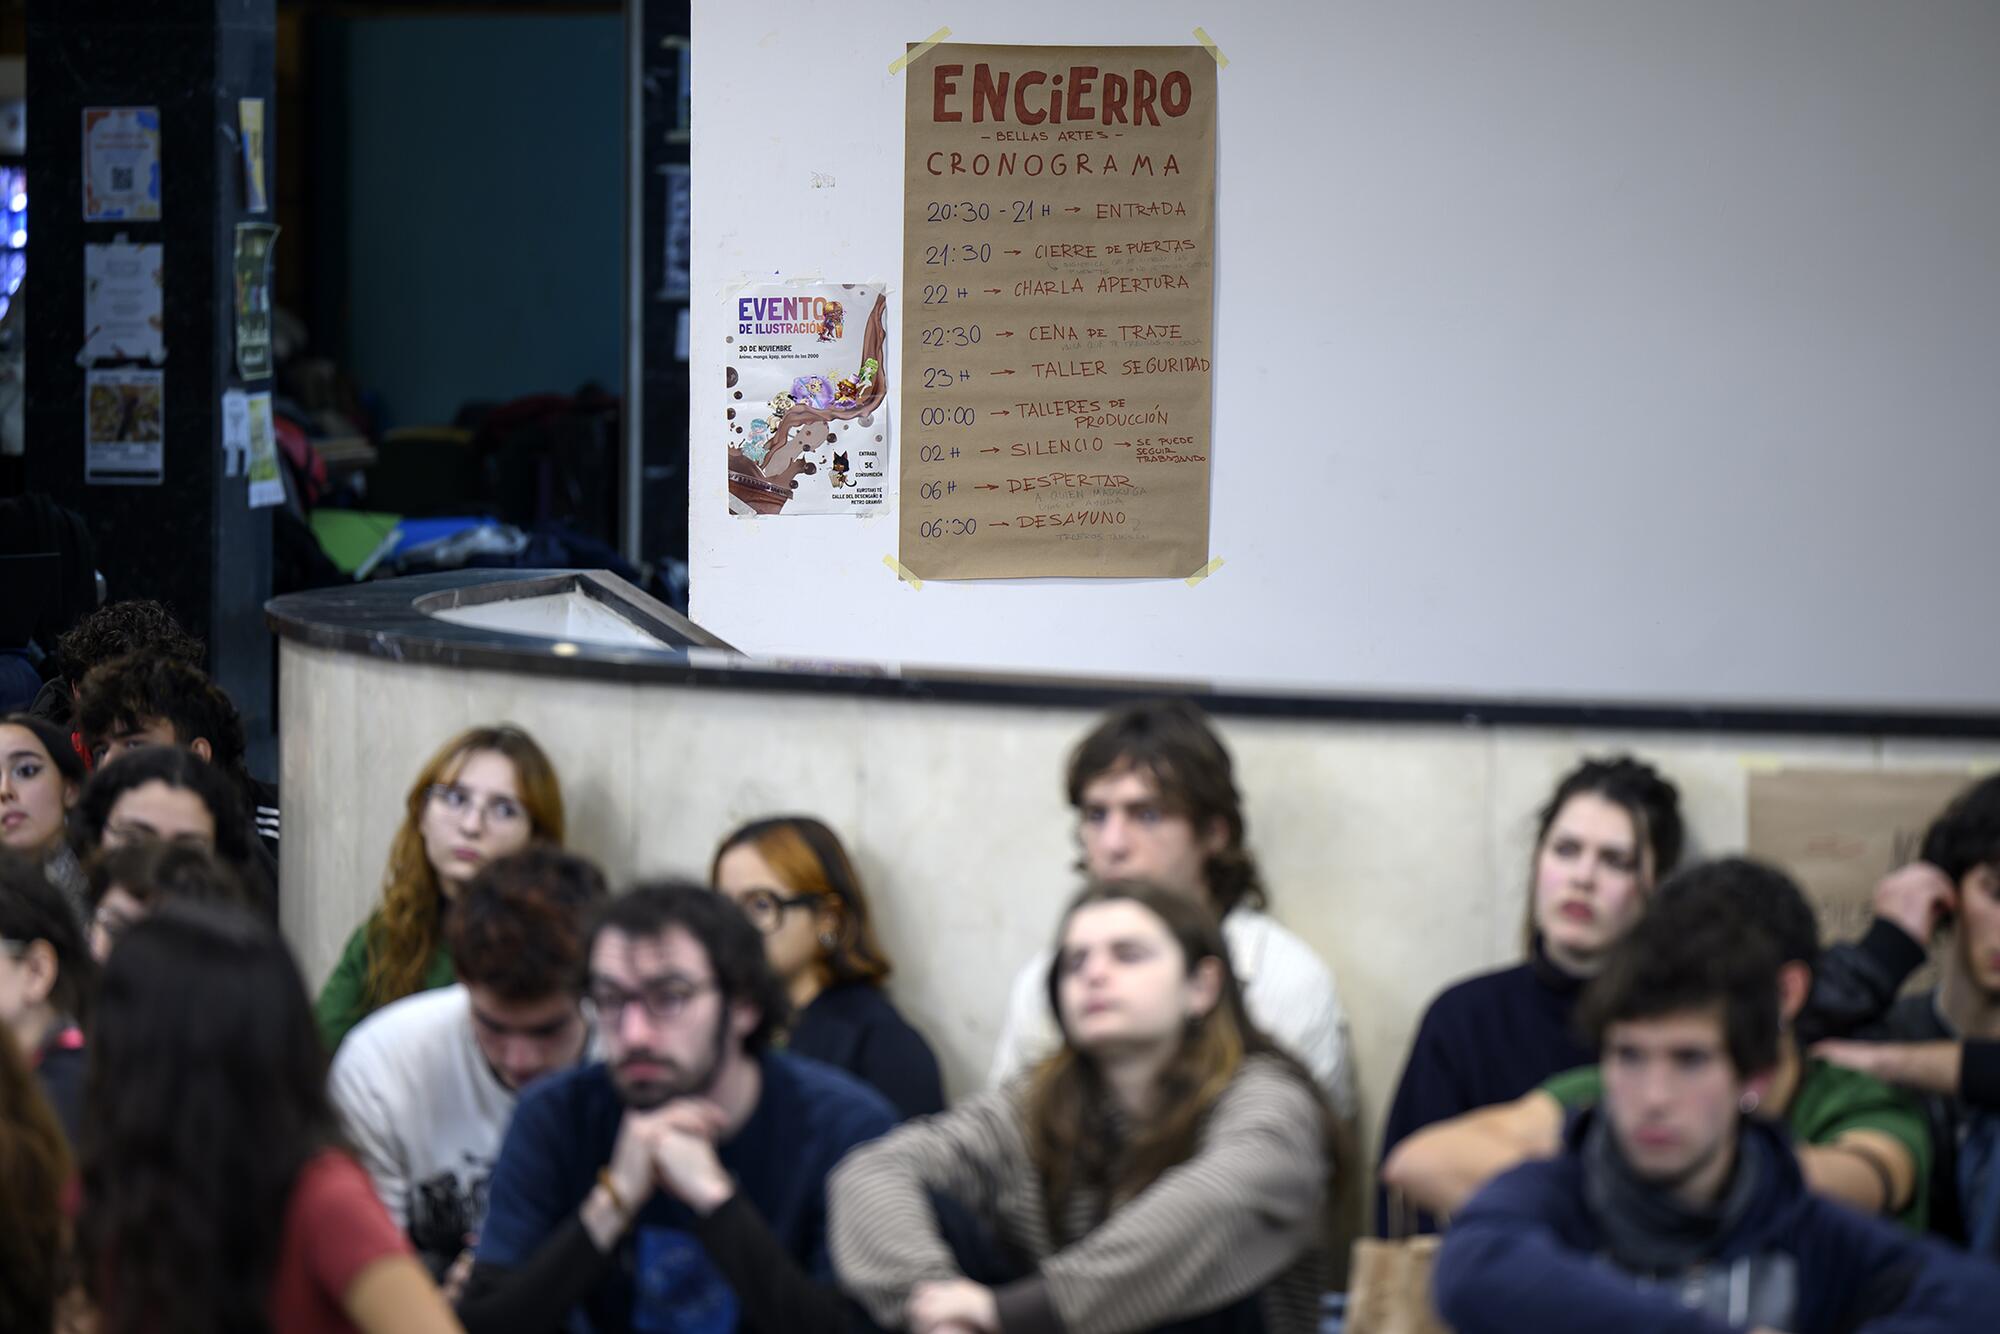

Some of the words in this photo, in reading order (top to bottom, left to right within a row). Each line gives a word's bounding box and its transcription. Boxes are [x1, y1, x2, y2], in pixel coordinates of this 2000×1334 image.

[996, 131, 1048, 141] BELLAS
[1058, 131, 1108, 140] ARTES
[927, 152, 1180, 176] CRONOGRAMA
[927, 201, 989, 222] 20:30
[1096, 202, 1186, 218] ENTRADA
[926, 244, 991, 266] 21:30
[1035, 244, 1097, 258] CIERRE
[1106, 245, 1122, 254] DE
[1127, 240, 1197, 255] PUERTAS
[924, 285, 948, 304] 22
[1014, 278, 1083, 297] CHARLA
[1097, 276, 1189, 294] APERTURA
[739, 297, 827, 320] EVENTO
[739, 324, 752, 334] DE
[922, 325, 981, 346] 22:30
[1029, 325, 1078, 340] CENA
[1088, 329, 1107, 338] DE
[1118, 324, 1183, 340] TRAJE
[923, 368, 953, 388] 23
[1032, 361, 1107, 378] TALLER
[1122, 357, 1210, 375] SEGURIDAD
[921, 407, 975, 426] 00:00
[1016, 400, 1100, 418] TALLERES
[1109, 399, 1126, 408] DE
[1075, 405, 1169, 428] PRODUCCIÓN
[920, 446, 944, 462] 02
[1011, 438, 1103, 456] SILENCIO
[1158, 437, 1193, 445] PUEDE
[1136, 455, 1206, 463] TRABAJANDO
[920, 481, 942, 499] 06
[1007, 472, 1134, 493] DESPERTAR
[920, 518, 977, 538] 06:30
[1016, 511, 1126, 528] DESAYUNO
